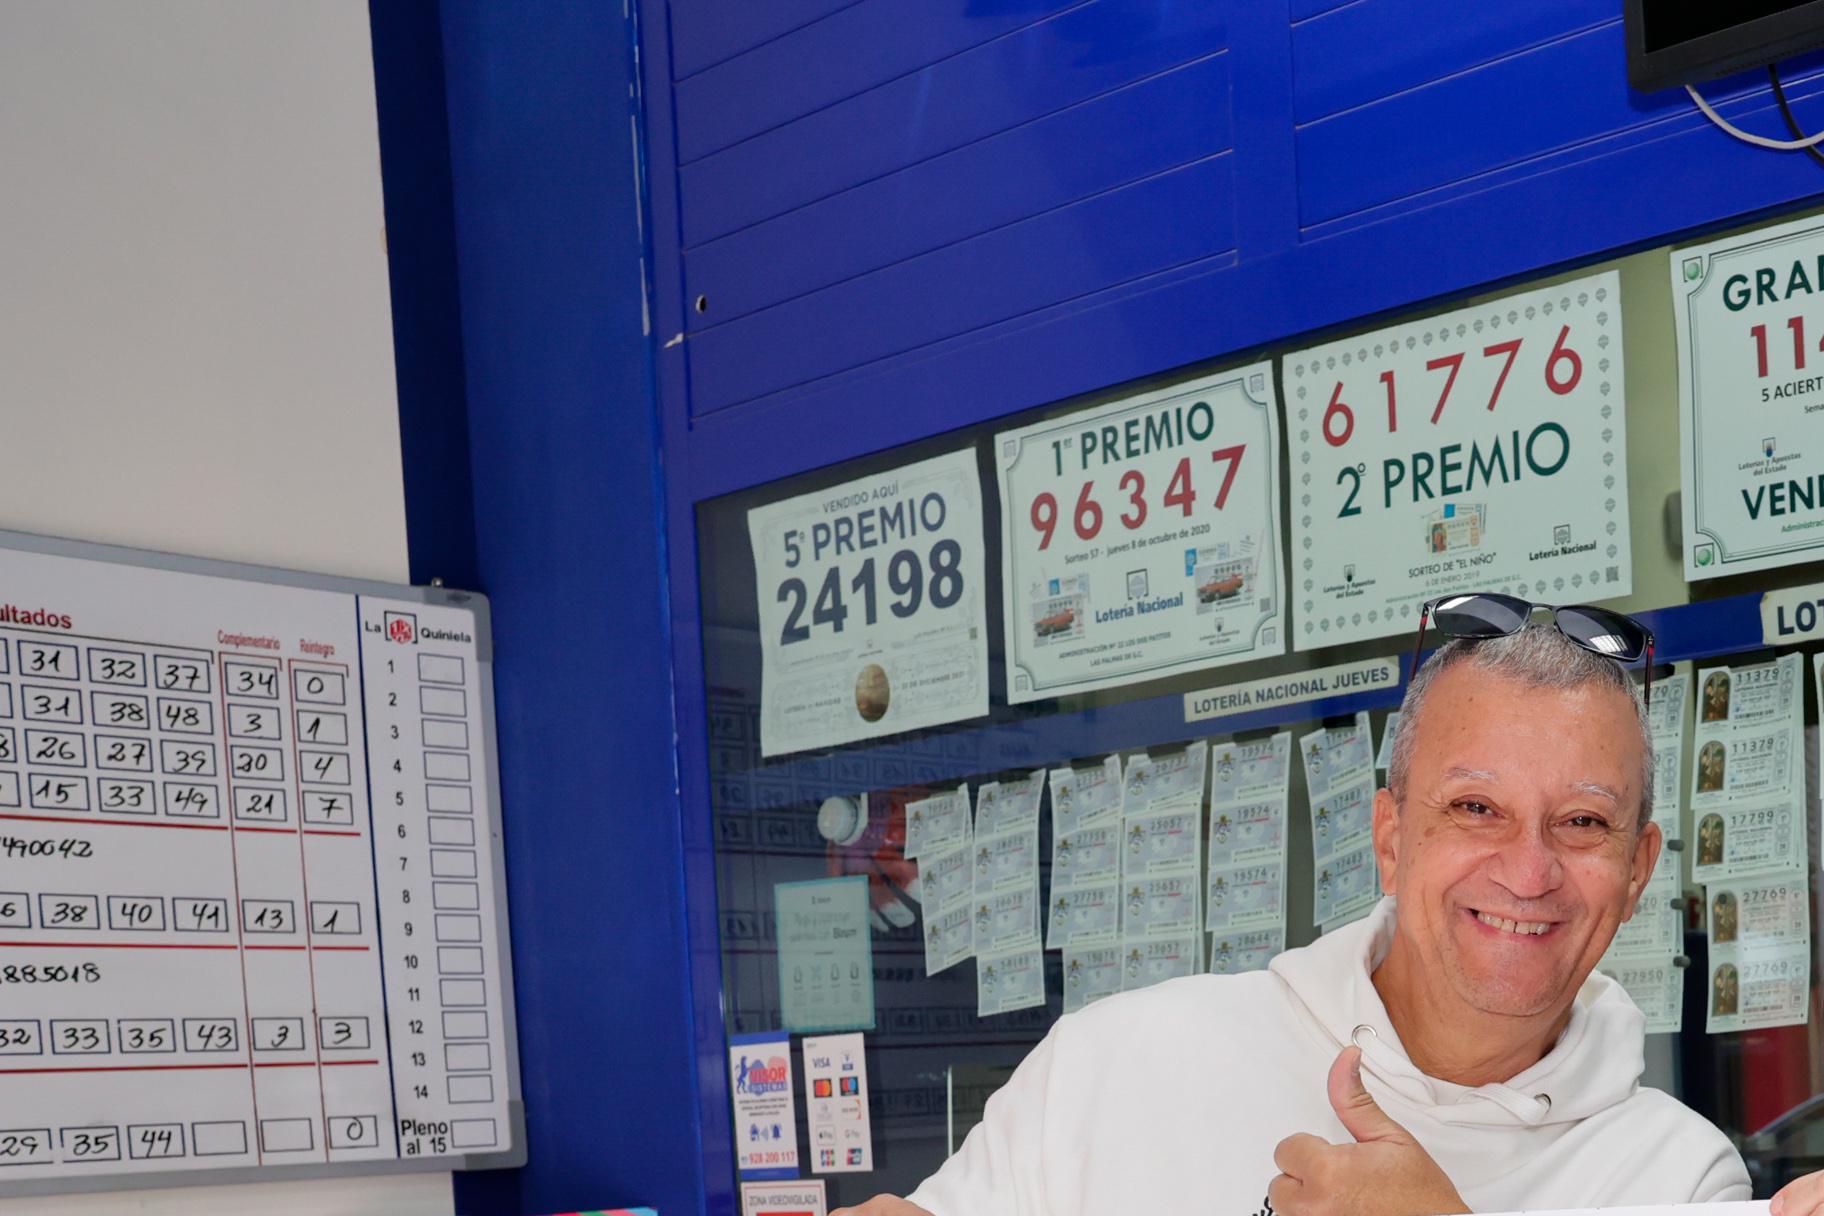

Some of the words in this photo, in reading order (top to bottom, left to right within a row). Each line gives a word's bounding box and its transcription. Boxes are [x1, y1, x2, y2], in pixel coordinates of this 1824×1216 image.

[1323, 325, 1582, 447] 61776
[1762, 388, 1769, 402] 5
[1081, 402, 1213, 469] PREMIO
[1337, 463, 1365, 518] 2º
[1384, 422, 1569, 508] PREMIO
[823, 492, 871, 513] VENDIDO
[872, 480, 898, 499] AQUÍ
[1031, 444, 1246, 551] 96347
[812, 493, 945, 560] PREMIO
[1561, 541, 1596, 554] Nacional
[1409, 564, 1440, 578] SORTEO
[1443, 561, 1453, 571] DE
[777, 539, 963, 646] 24198
[365, 621, 381, 632] La
[421, 628, 471, 643] Quiniela
[32, 650, 60, 671] 31
[101, 658, 135, 679] 32
[163, 663, 201, 689] 37
[238, 670, 276, 696] 34
[1195, 692, 1251, 713] LOTERÍA
[1257, 681, 1328, 703] NACIONAL
[1335, 668, 1389, 689] JUEVES
[401, 1119, 449, 1136] Pleno
[407, 1139, 420, 1154] al
[430, 1138, 447, 1154] 15
